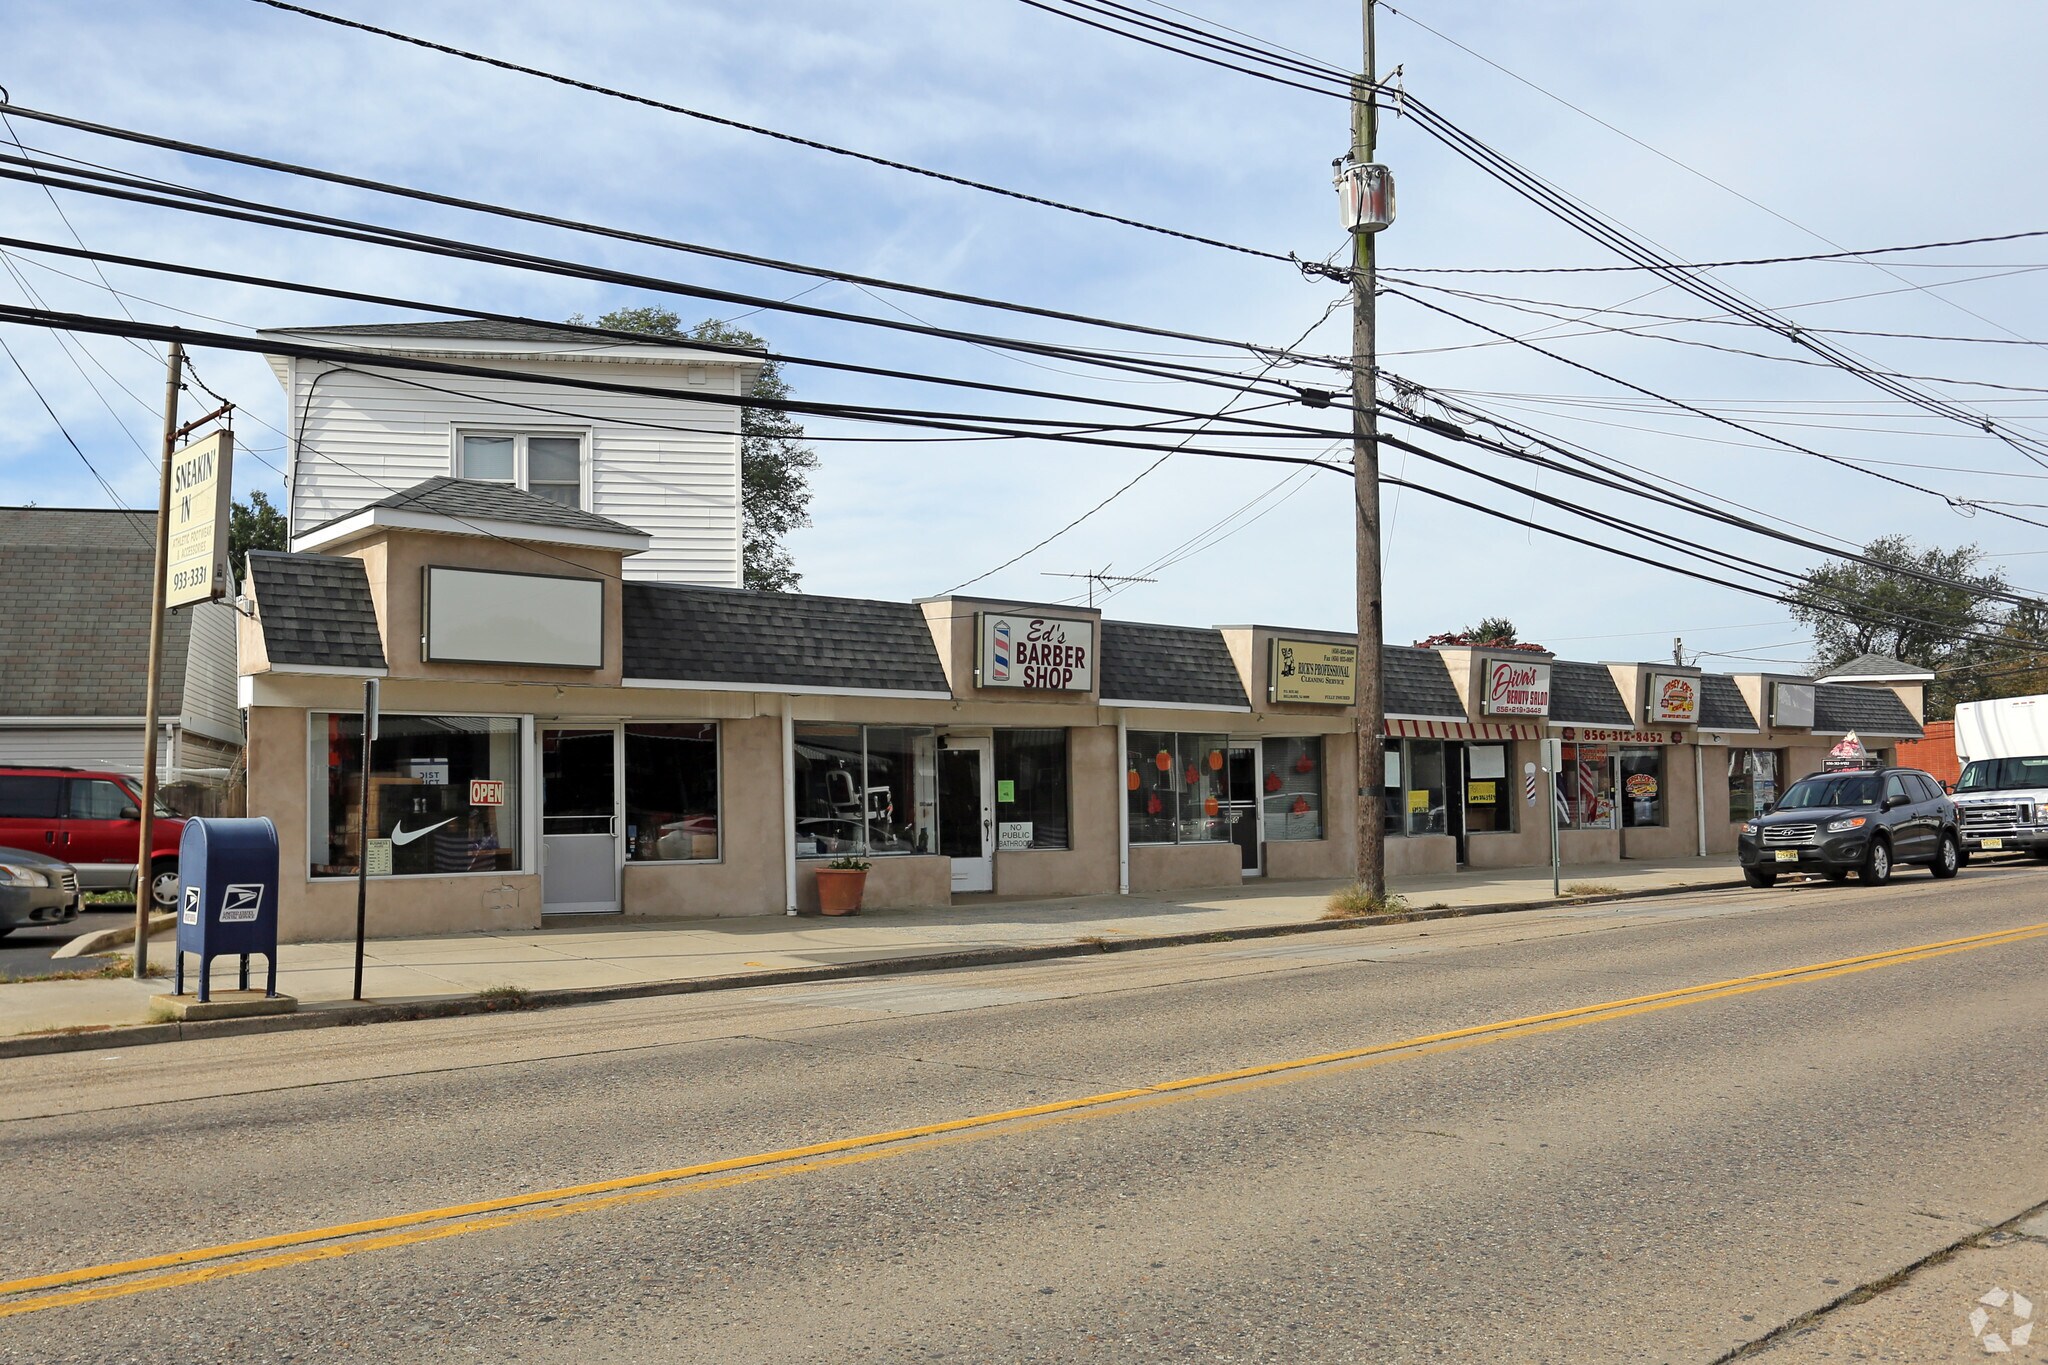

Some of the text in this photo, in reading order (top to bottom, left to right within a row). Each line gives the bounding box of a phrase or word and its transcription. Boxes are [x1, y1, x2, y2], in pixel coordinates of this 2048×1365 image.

[175, 448, 216, 494] SNEAKIN'
[181, 493, 192, 524] IN
[173, 565, 207, 592] 933-3331
[1026, 619, 1067, 645] Ed's
[1016, 641, 1086, 669] BARBER
[1023, 665, 1073, 689] SHOP
[1297, 662, 1350, 678] RICK'S PROFESSIONAL
[1491, 663, 1537, 702] Diva's
[1506, 689, 1548, 706] BEAUTY SALON
[1583, 729, 1664, 743] 856-312-8452
[472, 782, 502, 803] OPEN
[1001, 831, 1030, 839] PUBLIC
